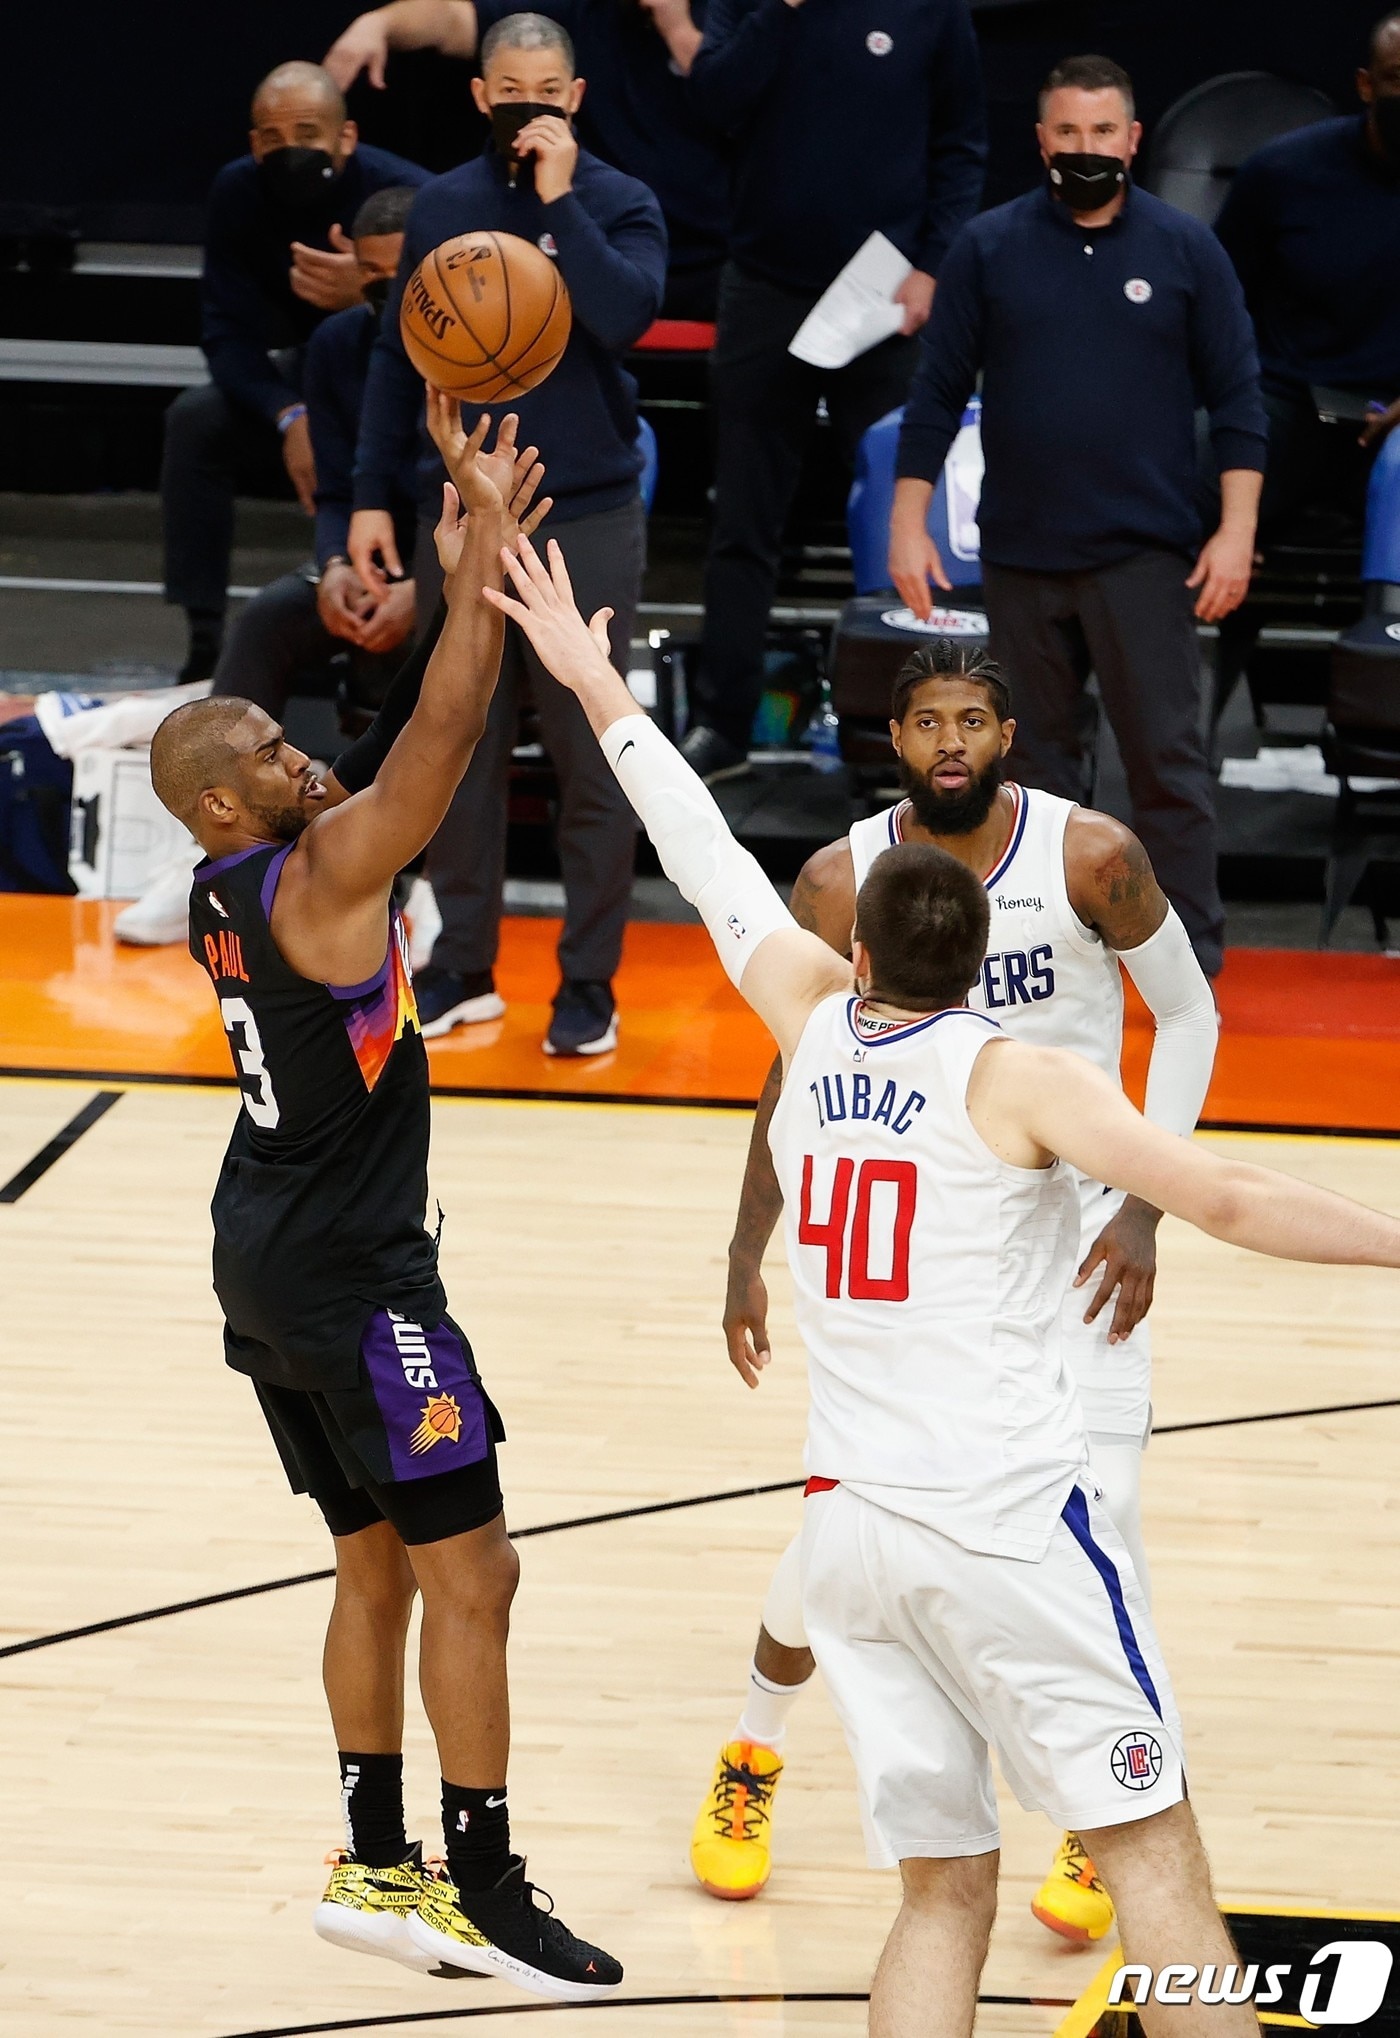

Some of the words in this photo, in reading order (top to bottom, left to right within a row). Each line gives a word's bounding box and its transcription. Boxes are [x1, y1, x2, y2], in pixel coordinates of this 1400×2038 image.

[410, 268, 456, 340] SPALD
[995, 894, 1045, 912] honey
[203, 930, 250, 983] PAUL
[220, 997, 280, 1129] 3
[798, 1154, 917, 1302] 40
[422, 1907, 449, 1934] CROSS
